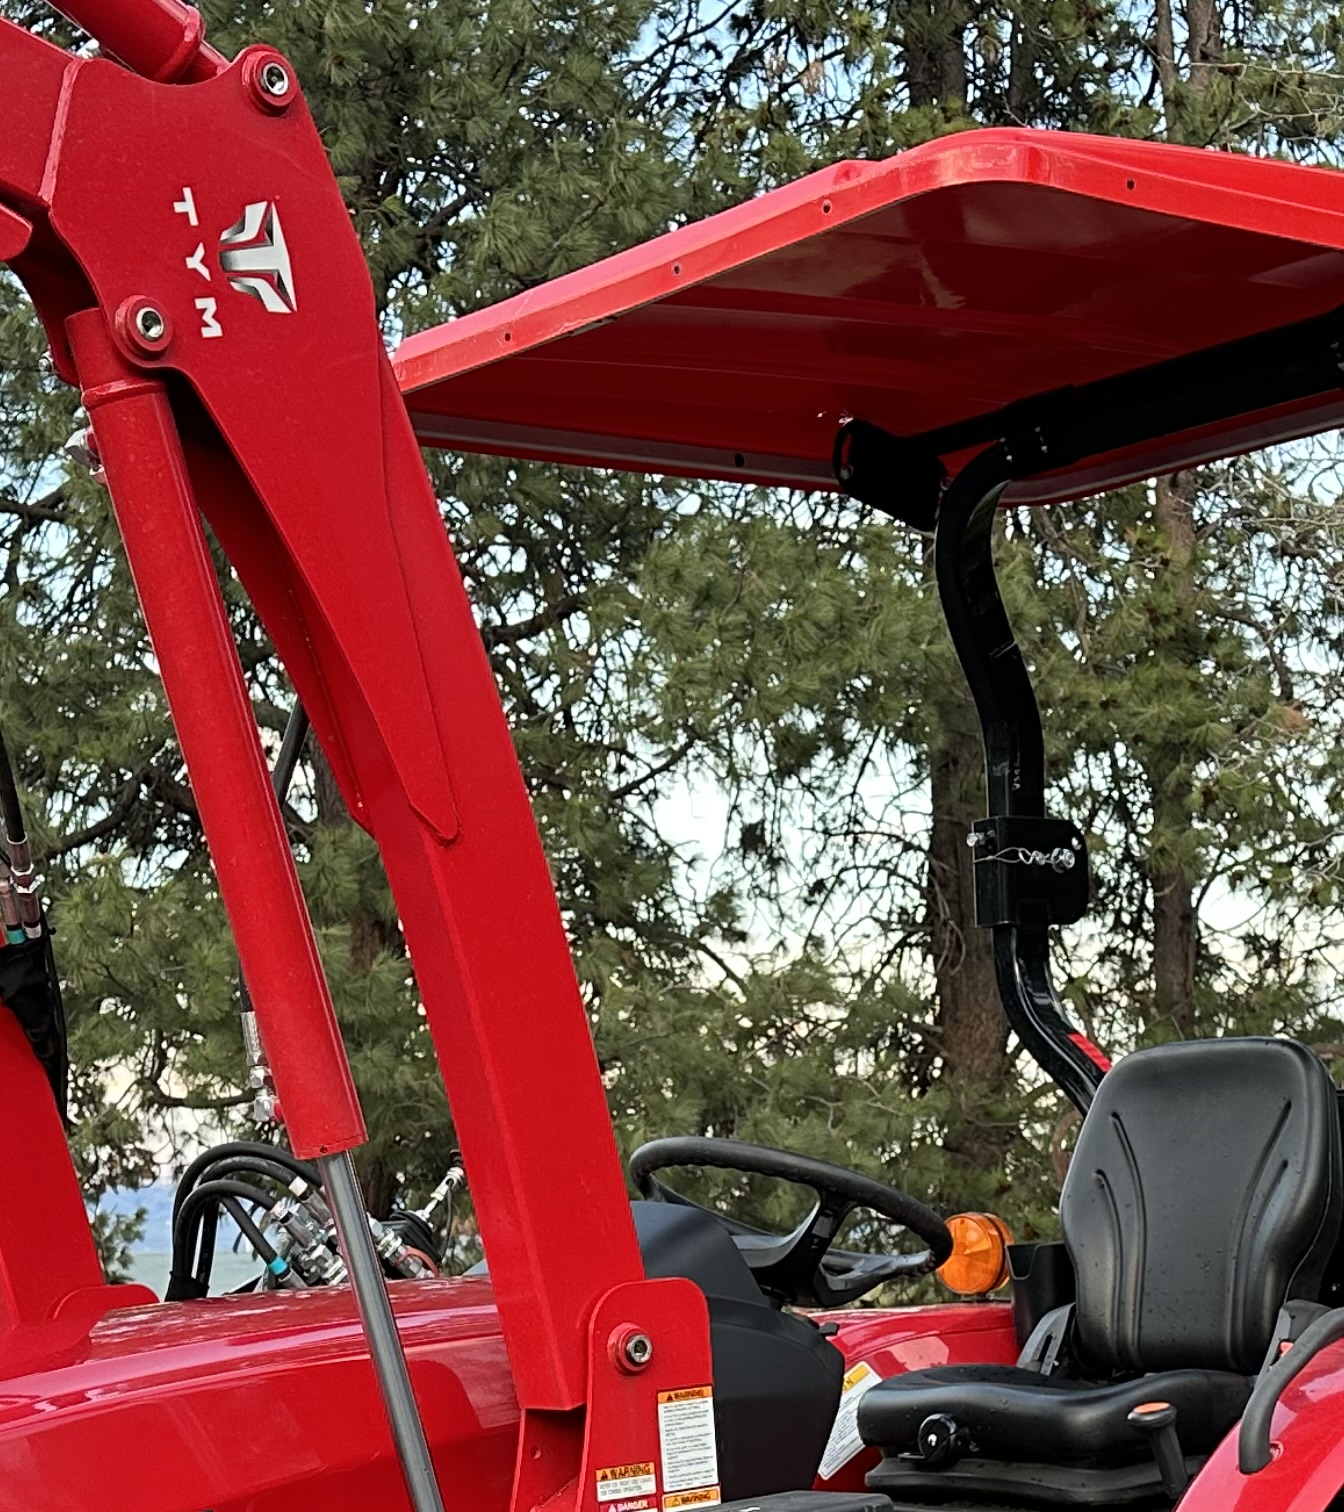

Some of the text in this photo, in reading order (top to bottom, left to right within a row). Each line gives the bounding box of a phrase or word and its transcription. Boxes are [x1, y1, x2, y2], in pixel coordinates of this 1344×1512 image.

[173, 187, 223, 338] TYM
[609, 1464, 651, 1479] WARNING
[617, 1499, 648, 1512] DANGER
